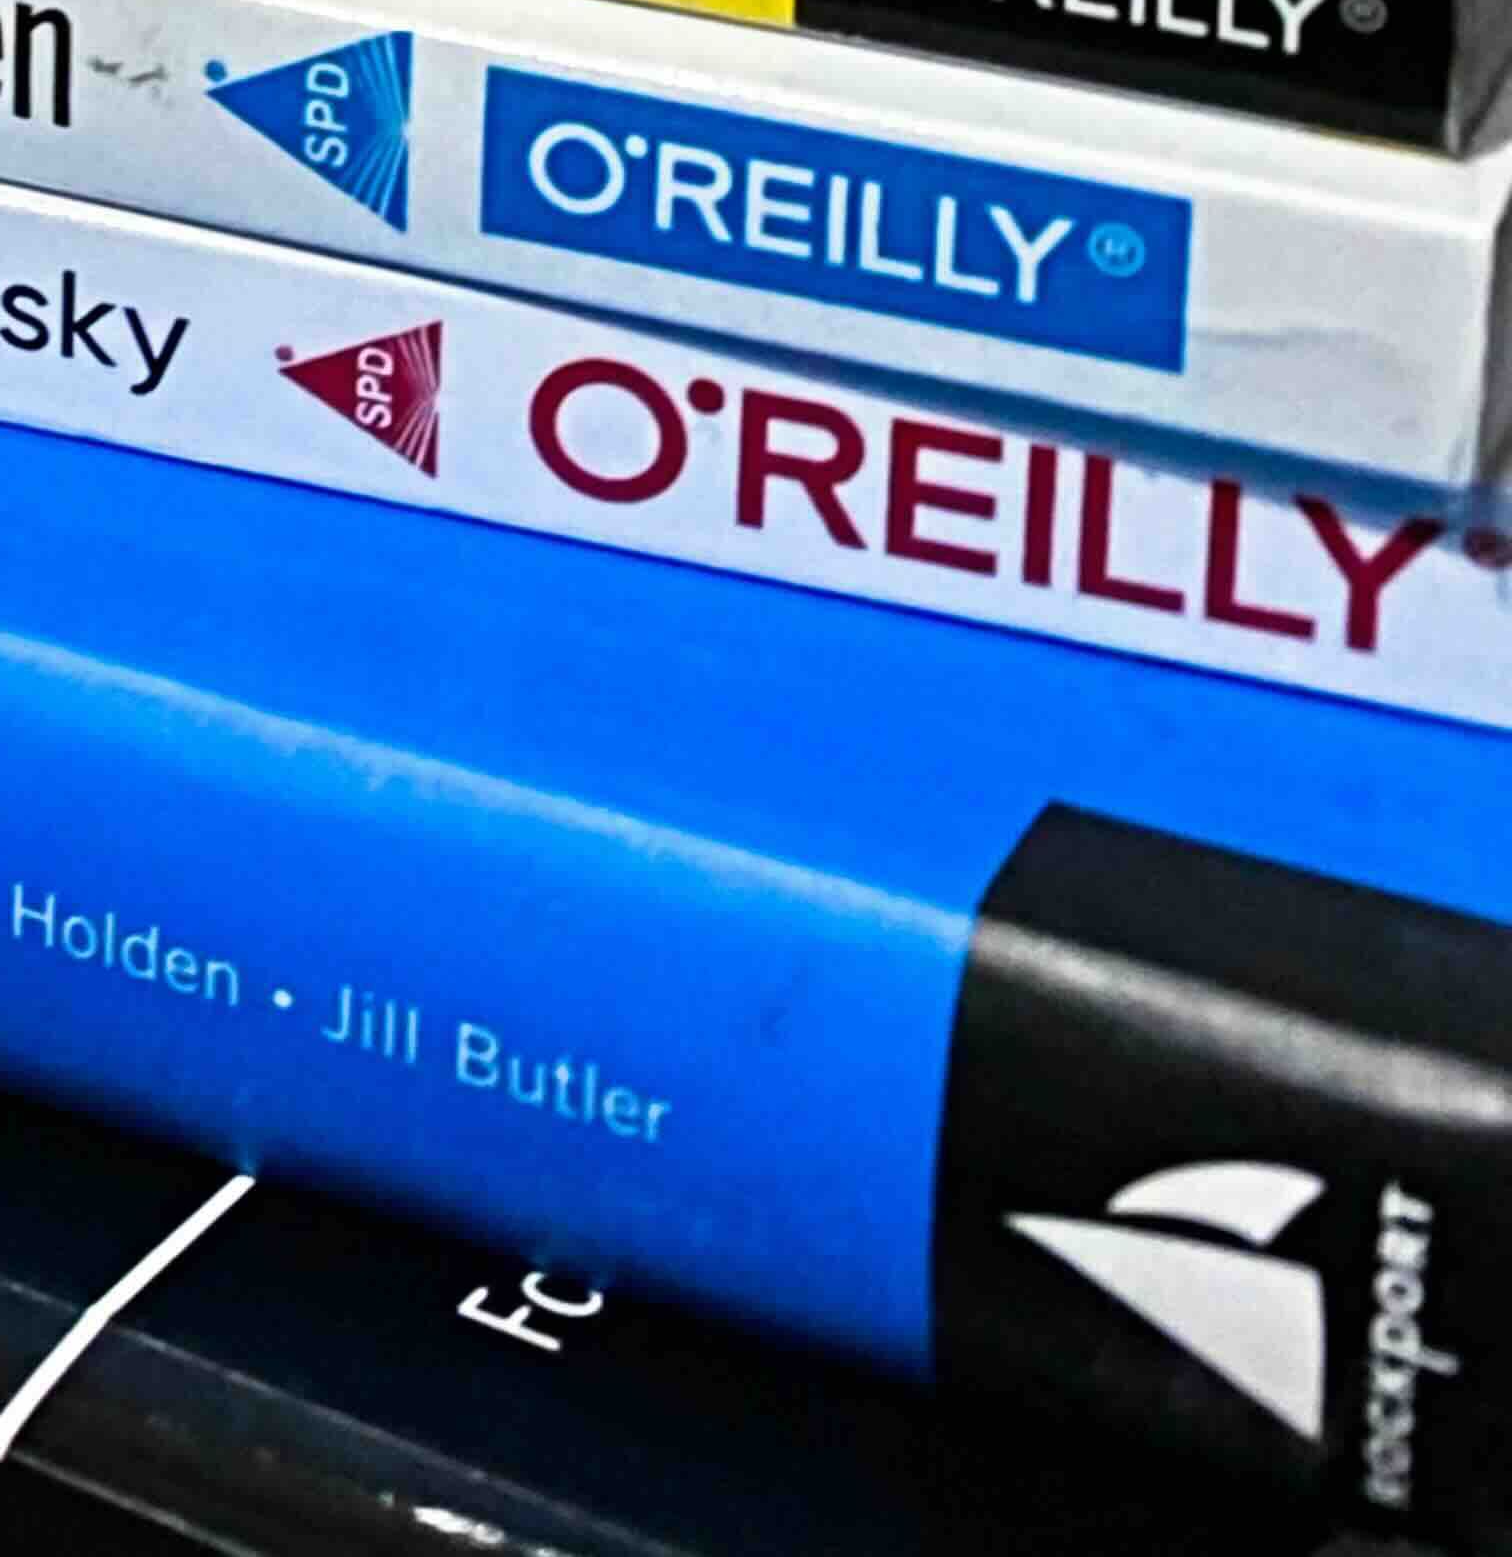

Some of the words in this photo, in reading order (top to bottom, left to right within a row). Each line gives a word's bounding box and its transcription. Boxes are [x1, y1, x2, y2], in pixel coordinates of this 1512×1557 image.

[302, 62, 350, 167] SPD
[355, 346, 395, 430] SPD
[11, 884, 242, 1010] Holden
[322, 982, 418, 1065] Jill
[454, 1023, 671, 1146] Butler
